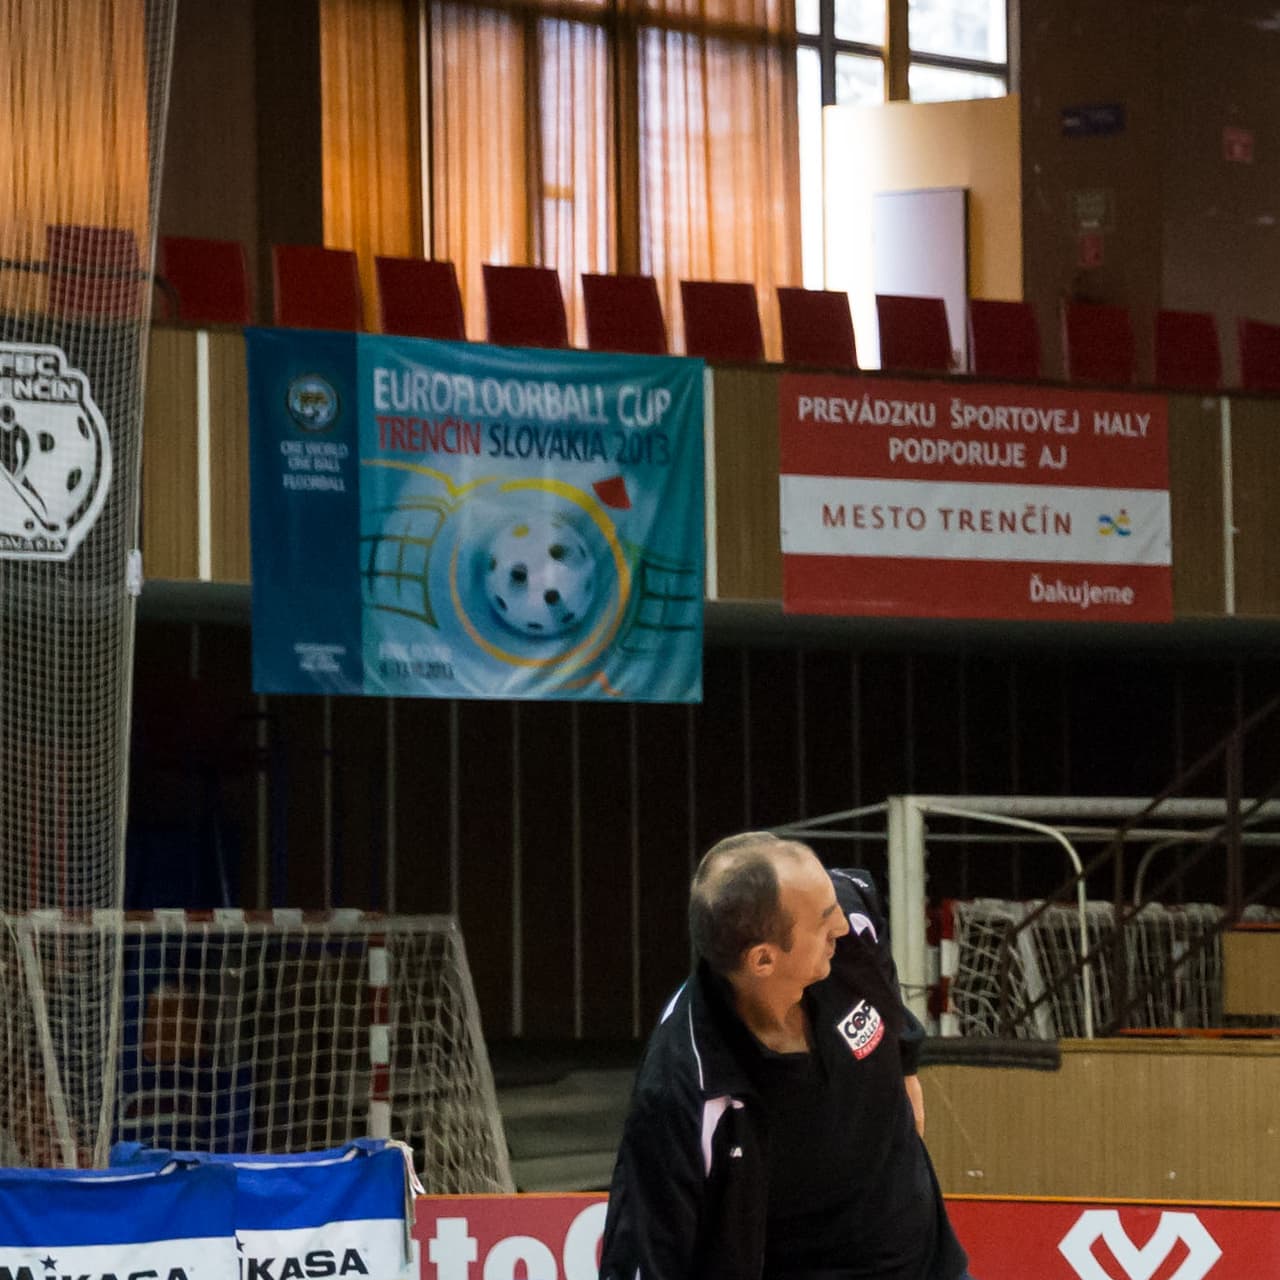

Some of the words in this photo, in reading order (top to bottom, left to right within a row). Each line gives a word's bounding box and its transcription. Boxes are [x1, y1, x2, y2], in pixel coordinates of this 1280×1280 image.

[373, 367, 609, 424] EUROFLOORBALL
[617, 384, 672, 428] CUP
[799, 393, 936, 428] PREVÁDZKU
[950, 398, 1079, 435] ŠPORTOVEJ
[1094, 411, 1151, 438] HALY
[489, 422, 608, 464] SLOVAKIA
[615, 430, 671, 467] 2013
[889, 438, 1025, 469] PODPORUJE
[1039, 445, 1068, 470] AJ
[822, 503, 927, 531] MESTO
[938, 504, 1072, 535] TRENČÍN
[1030, 574, 1135, 609] Ďakujeme
